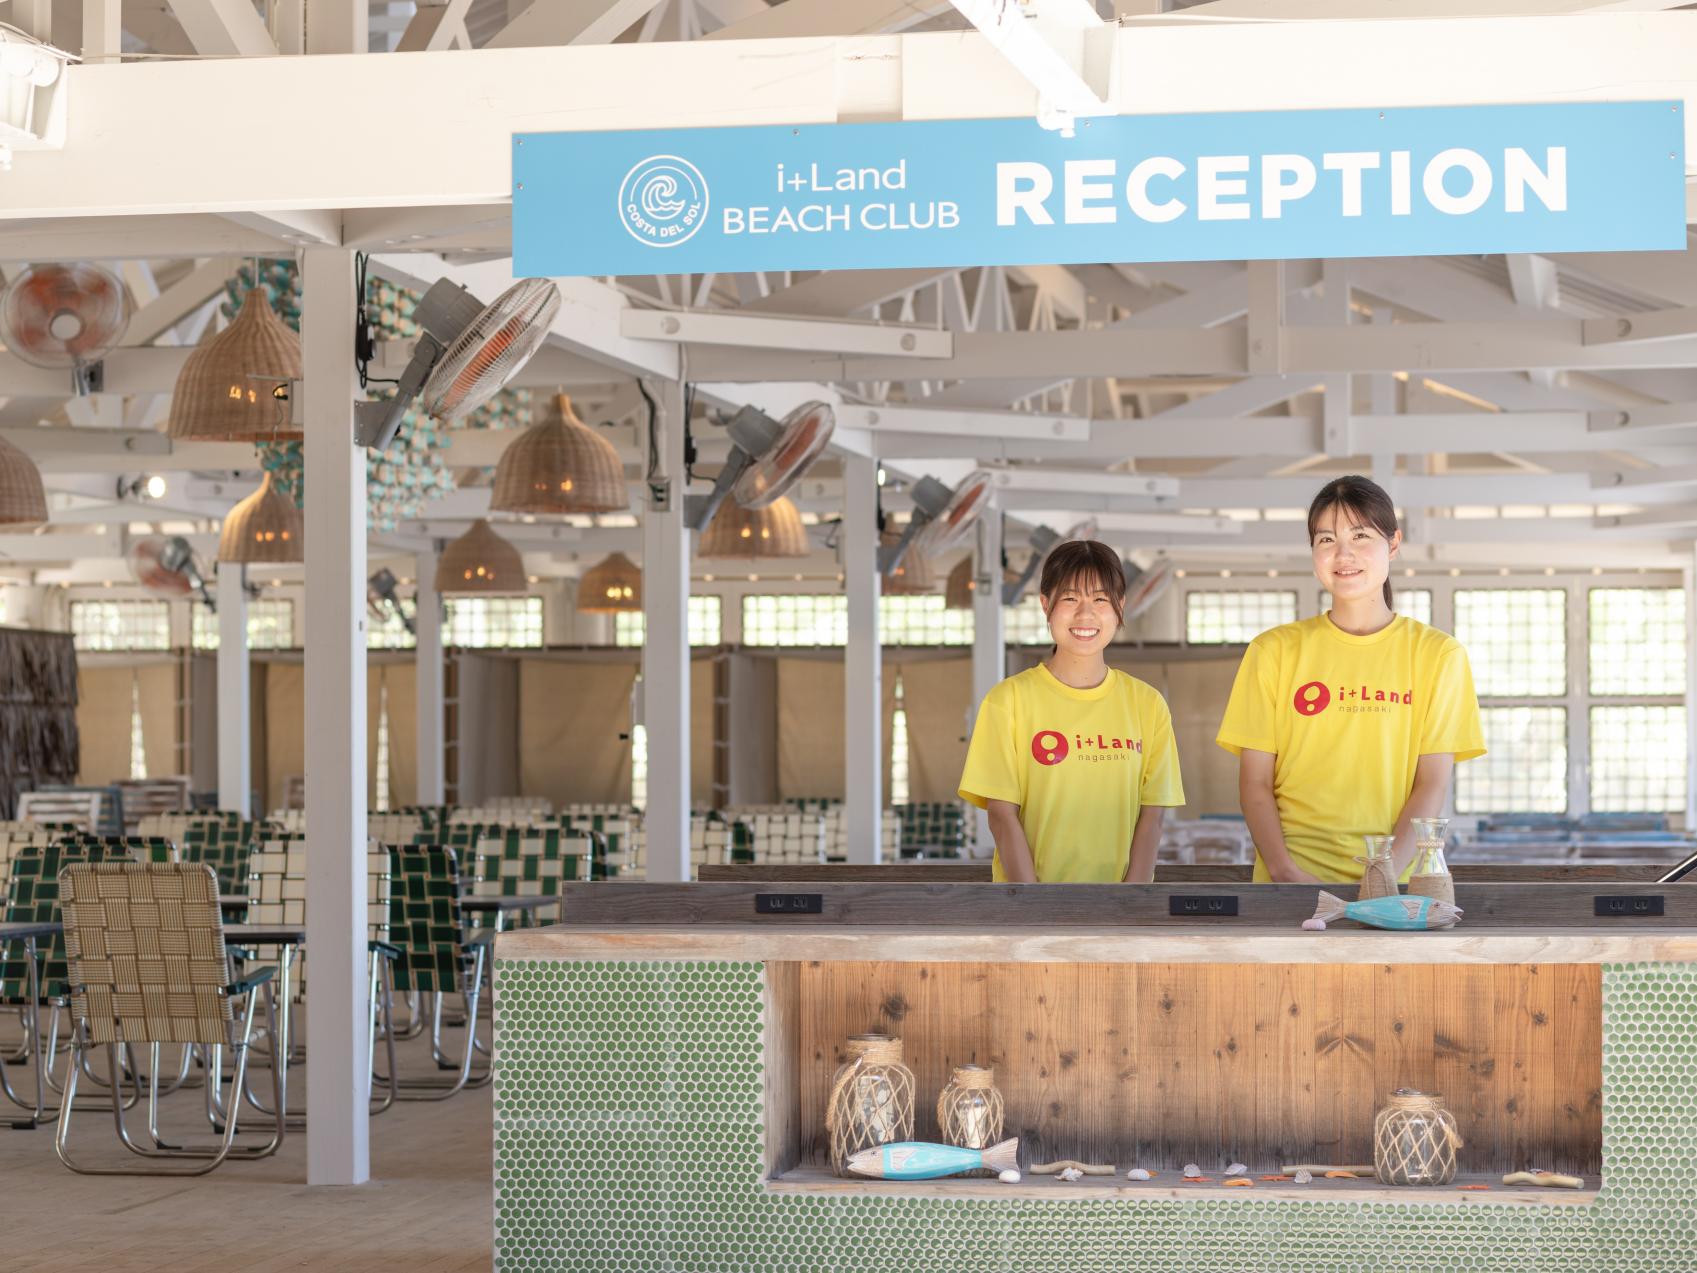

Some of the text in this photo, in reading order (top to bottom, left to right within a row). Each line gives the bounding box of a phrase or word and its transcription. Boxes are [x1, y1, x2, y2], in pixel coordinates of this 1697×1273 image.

[777, 159, 906, 193] i+Land
[996, 145, 1568, 227] RECEPTION
[627, 202, 701, 237] COSTA DEL SOL
[723, 201, 960, 234] BEACH CLUB
[1339, 686, 1413, 705] i+Land
[1339, 705, 1391, 714] nagasaki
[1075, 735, 1142, 754] i+Land
[1078, 752, 1130, 763] nagasaki
